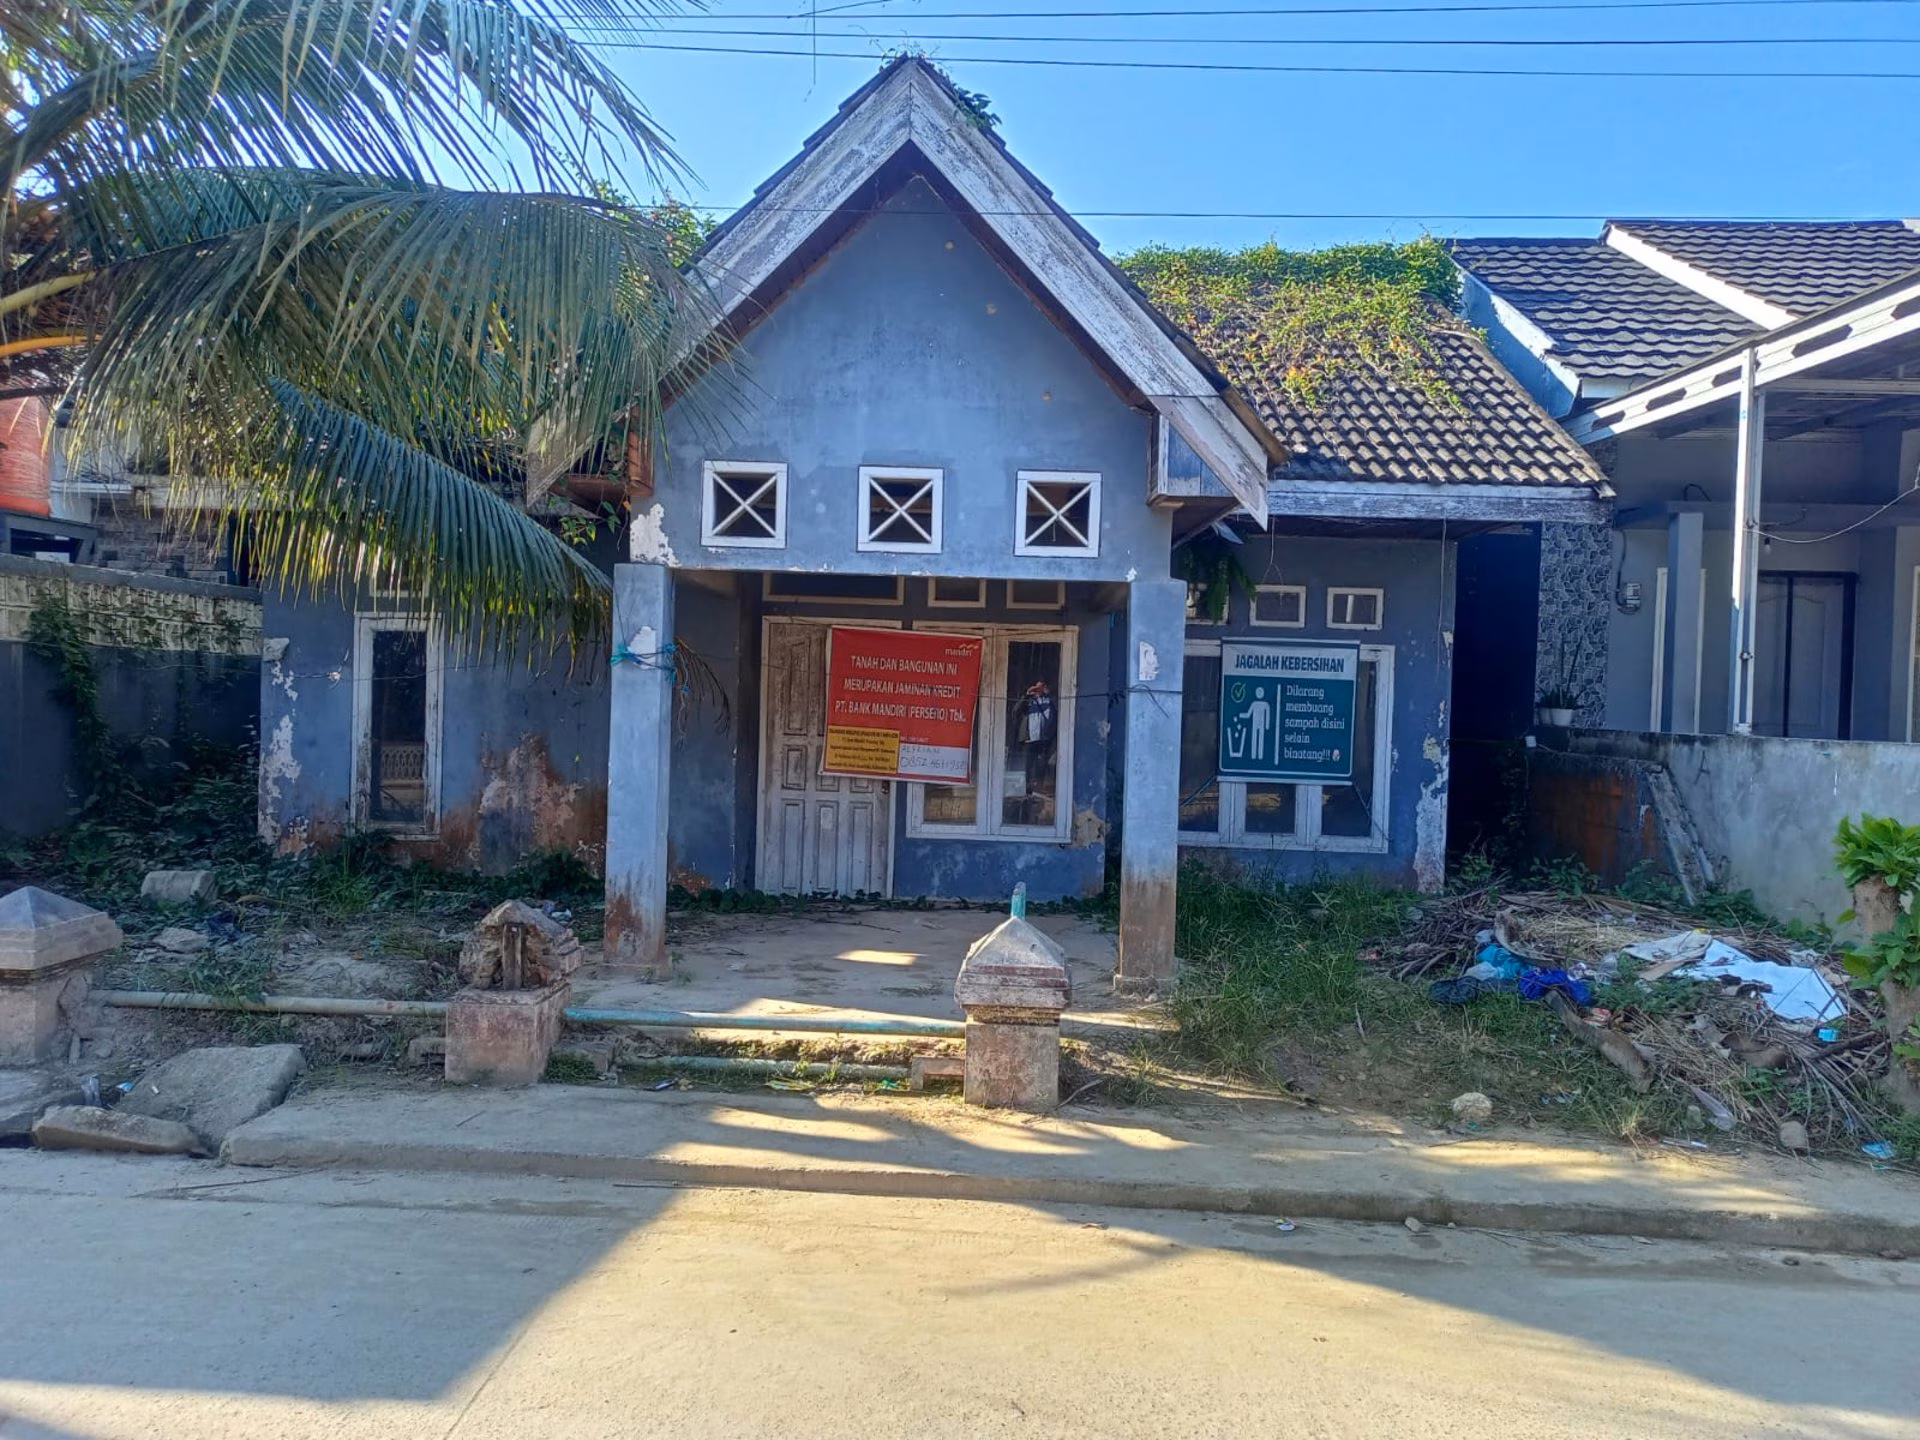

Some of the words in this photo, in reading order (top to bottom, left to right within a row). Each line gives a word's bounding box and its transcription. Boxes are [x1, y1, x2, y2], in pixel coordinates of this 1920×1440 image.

[945, 647, 972, 657] mandiri
[851, 655, 879, 670] TANAH
[880, 658, 897, 671] DAN
[899, 659, 944, 674] BANGUNAN
[946, 663, 957, 675] INI
[1235, 654, 1280, 670] JAGALAH
[1281, 655, 1345, 672] KEBERSIHAN
[844, 678, 893, 693] MERUPAKAN
[894, 682, 932, 697] JAMINAN
[933, 685, 960, 698] KREDIT
[1286, 685, 1325, 700] Dilarang
[835, 700, 847, 713] PT.
[849, 701, 871, 714] BANK
[872, 703, 906, 717] MANDIRI
[950, 708, 967, 722] Tbk.
[1285, 701, 1334, 715] membuang
[1284, 718, 1319, 731] sampah
[1320, 718, 1345, 730] disini
[1284, 732, 1310, 744] selain
[1284, 748, 1331, 762] binatang!!!
